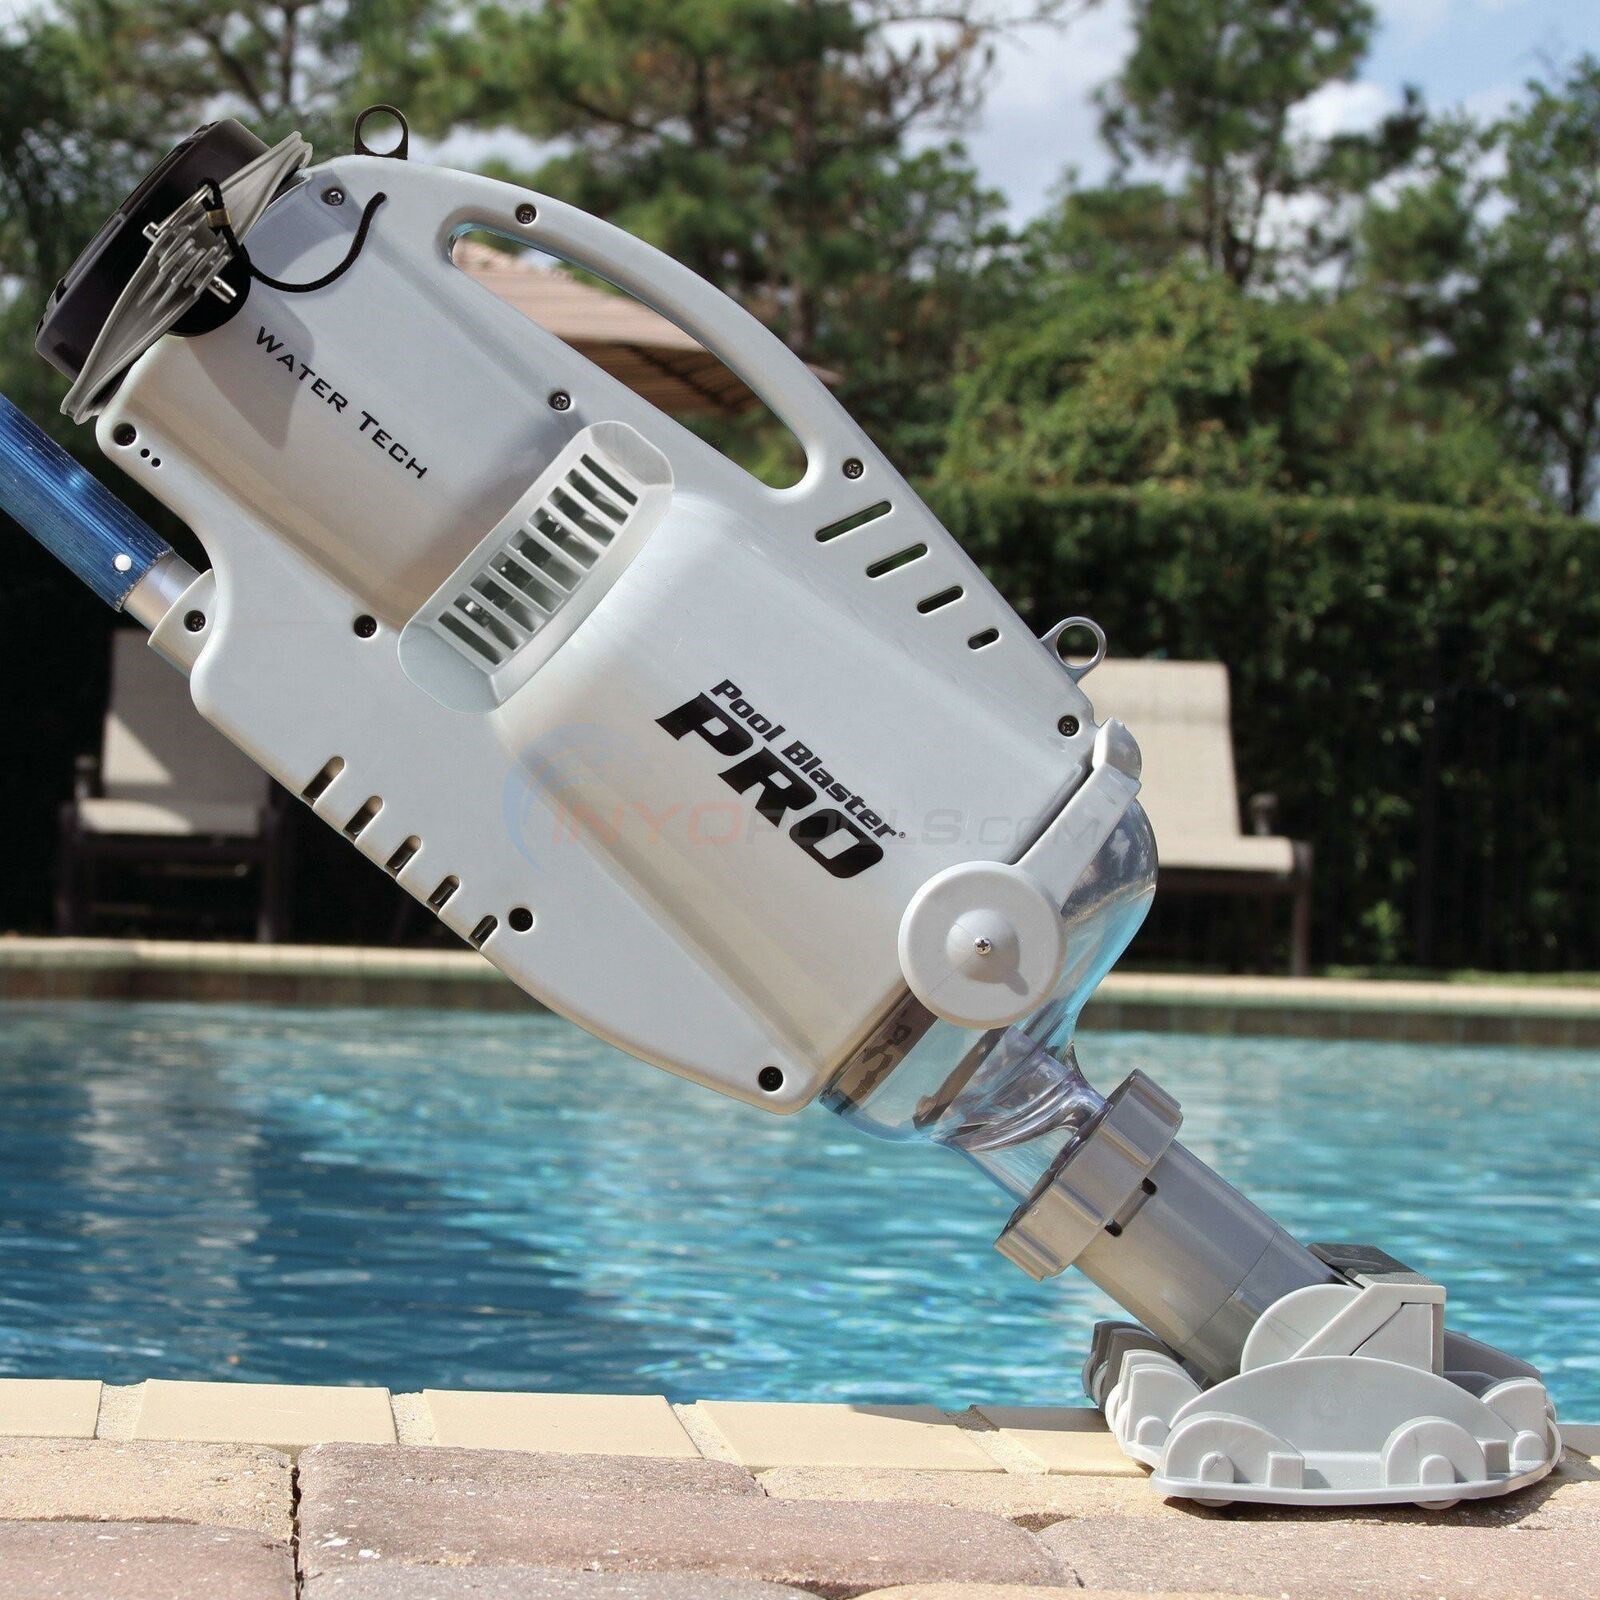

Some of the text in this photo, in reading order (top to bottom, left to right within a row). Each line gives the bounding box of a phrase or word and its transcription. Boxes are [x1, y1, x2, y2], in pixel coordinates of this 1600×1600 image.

[256, 326, 428, 479] WATER TECH
[655, 692, 884, 878] PRO
[710, 678, 786, 742] Pool
